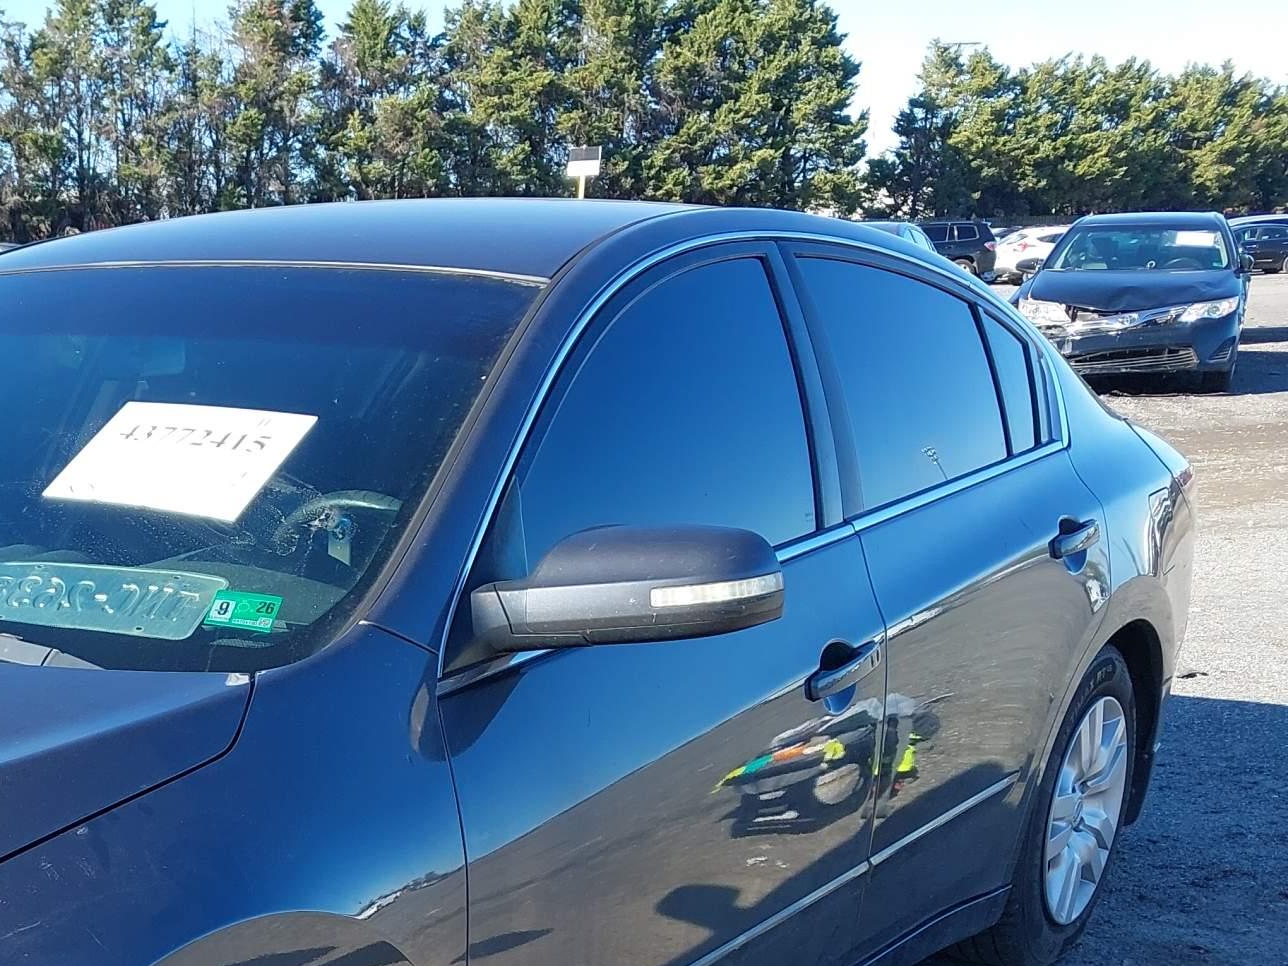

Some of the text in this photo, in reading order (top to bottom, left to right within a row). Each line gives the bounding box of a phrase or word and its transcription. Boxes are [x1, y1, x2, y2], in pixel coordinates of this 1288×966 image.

[120, 424, 272, 452] 43772415
[217, 601, 276, 616] 9 26
